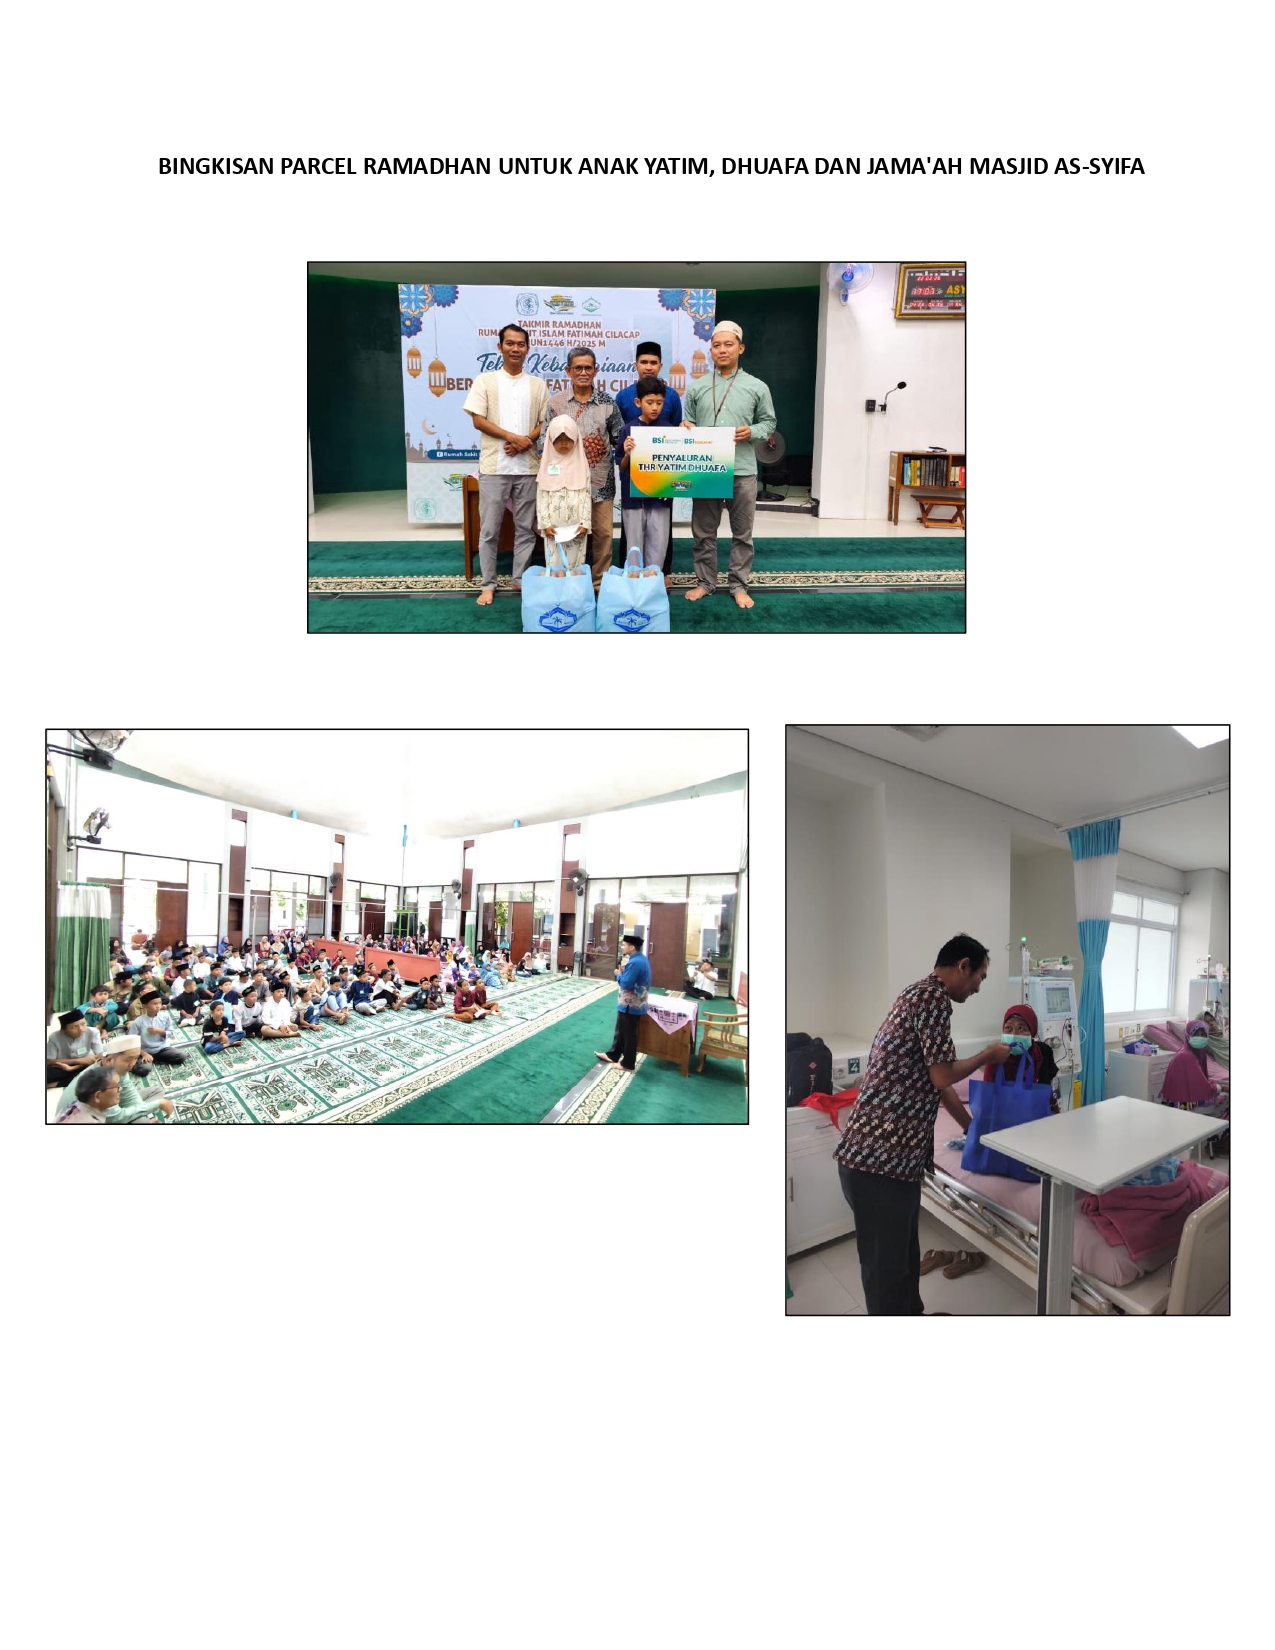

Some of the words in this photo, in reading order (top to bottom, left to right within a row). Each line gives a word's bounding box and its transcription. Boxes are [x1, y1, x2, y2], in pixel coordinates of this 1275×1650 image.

[518, 320, 550, 328] TAKMIR
[552, 321, 601, 329] RAMADHAN
[539, 329, 564, 338] ISLAM
[567, 330, 603, 338] FATIMAH
[605, 331, 640, 339] CILACAP
[567, 339, 596, 348] H/2025
[476, 352, 503, 373] Teb
[652, 454, 713, 462] PENYALURAN
[638, 463, 656, 471] THR
[657, 463, 687, 471] YATIM
[688, 464, 726, 472] DHUAFA
